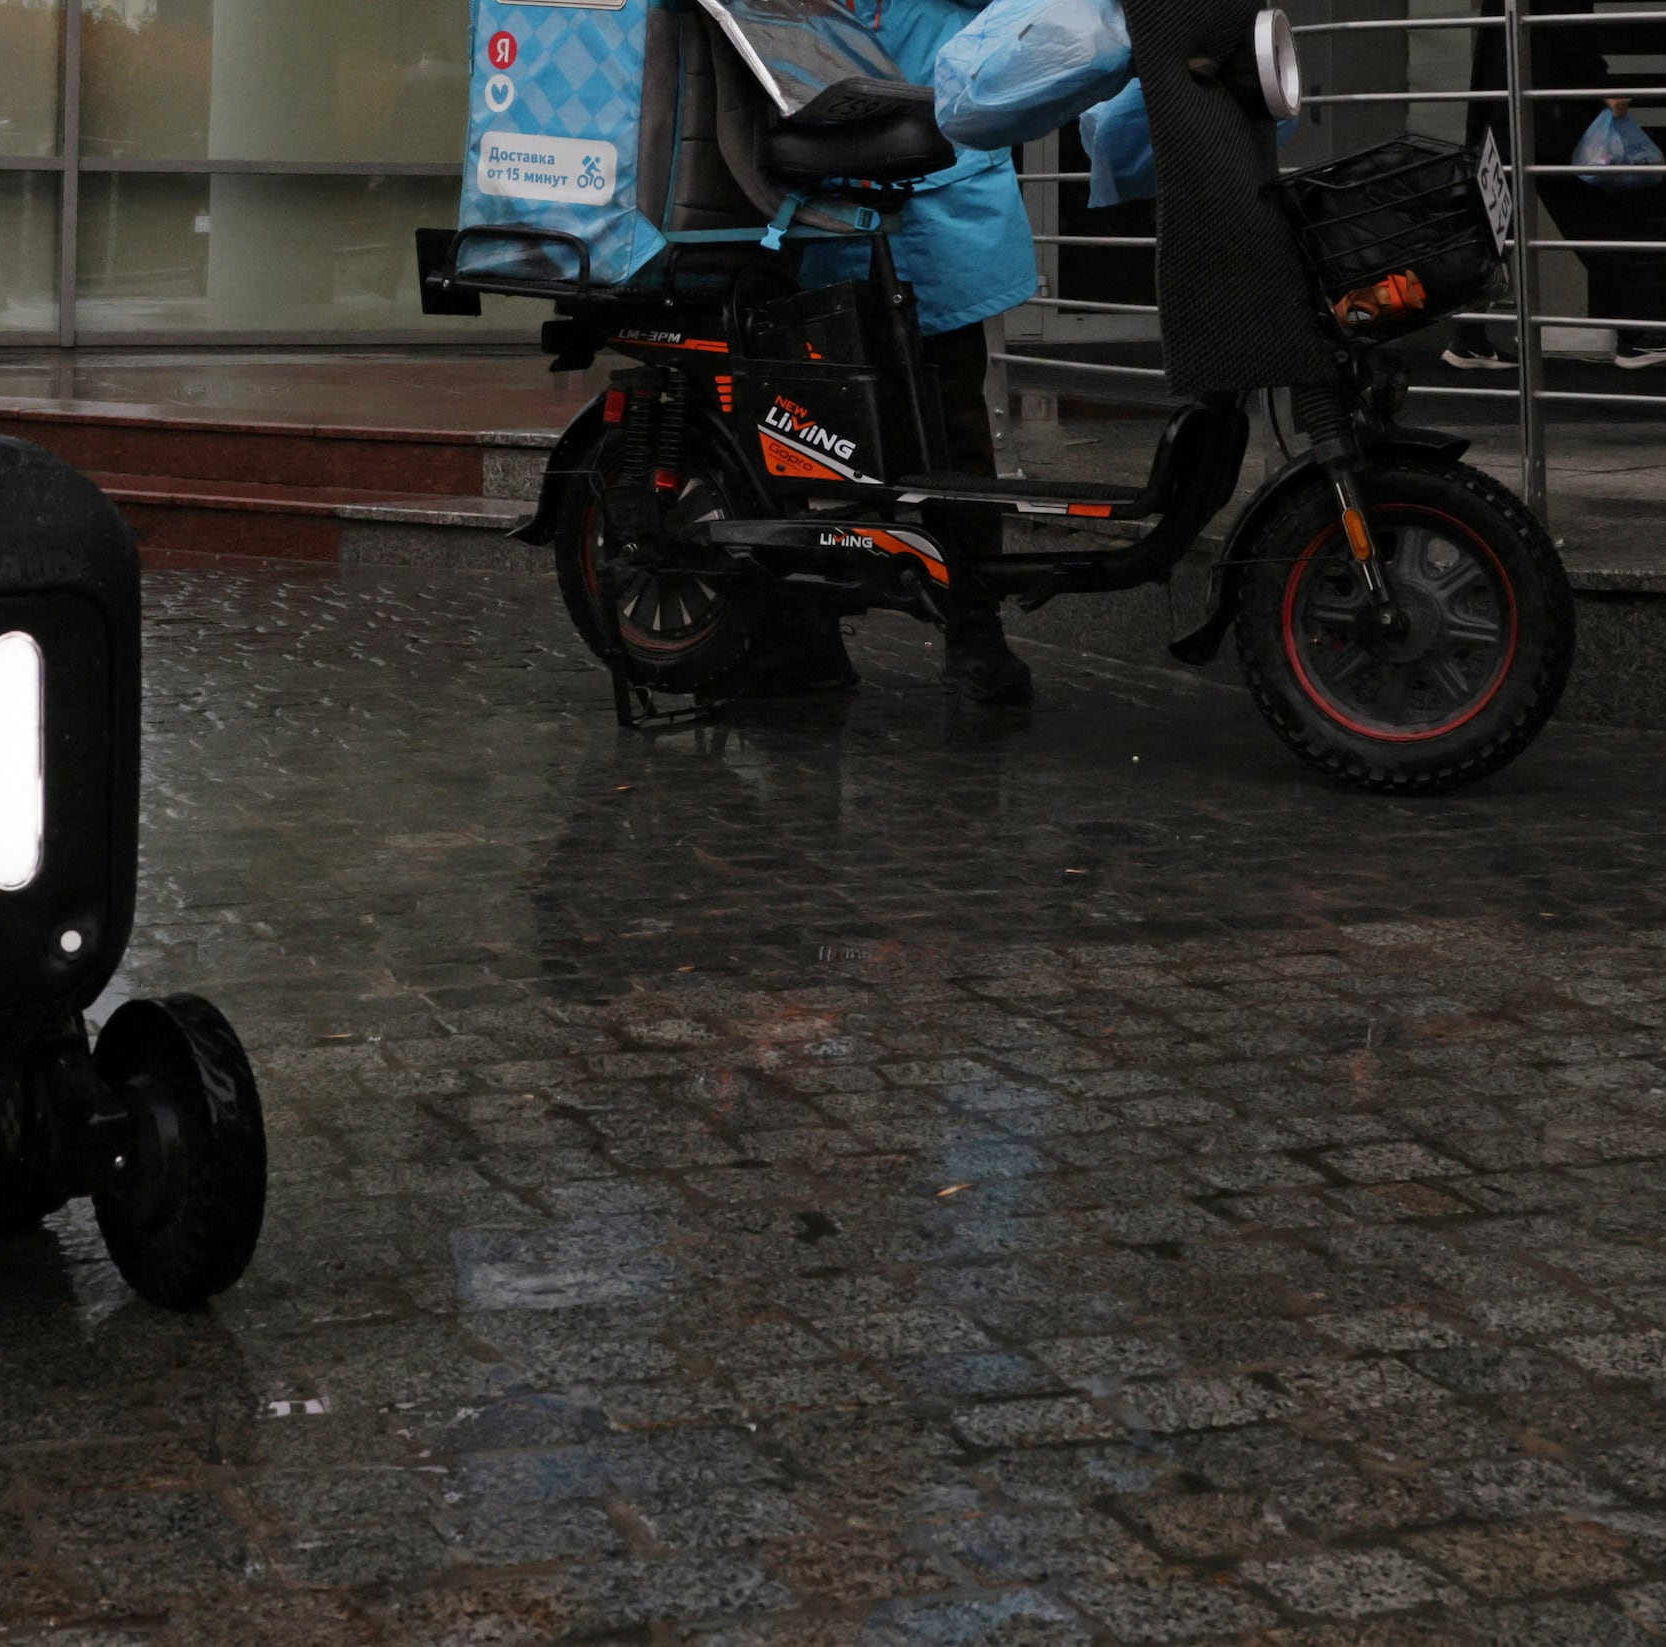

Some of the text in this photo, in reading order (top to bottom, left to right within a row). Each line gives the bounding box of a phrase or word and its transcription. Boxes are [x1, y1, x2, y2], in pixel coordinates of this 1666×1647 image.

[489, 147, 555, 166] Доставка
[487, 167, 568, 187] от 15 минут
[774, 395, 808, 418] NEW
